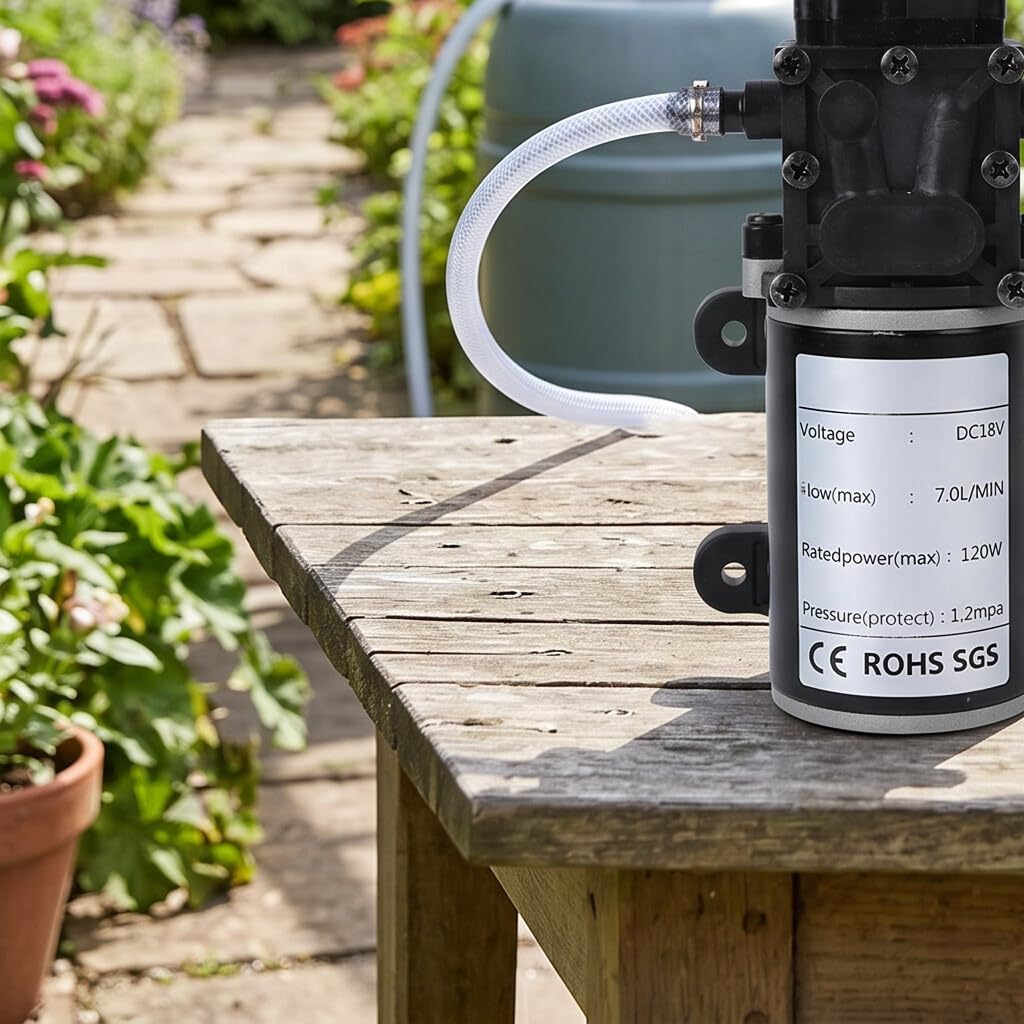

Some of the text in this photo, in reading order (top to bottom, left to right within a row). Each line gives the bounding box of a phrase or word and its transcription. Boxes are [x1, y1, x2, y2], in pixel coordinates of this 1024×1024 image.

[799, 421, 856, 446] Voltage
[956, 419, 1006, 442] DC18V
[935, 479, 1005, 504] 7.0L/MIN
[801, 541, 941, 569] Ratedpower(max)
[961, 540, 1004, 563] 120W
[802, 600, 935, 629] Pressure(protect)
[808, 641, 1000, 679] CE ROHS SGS
